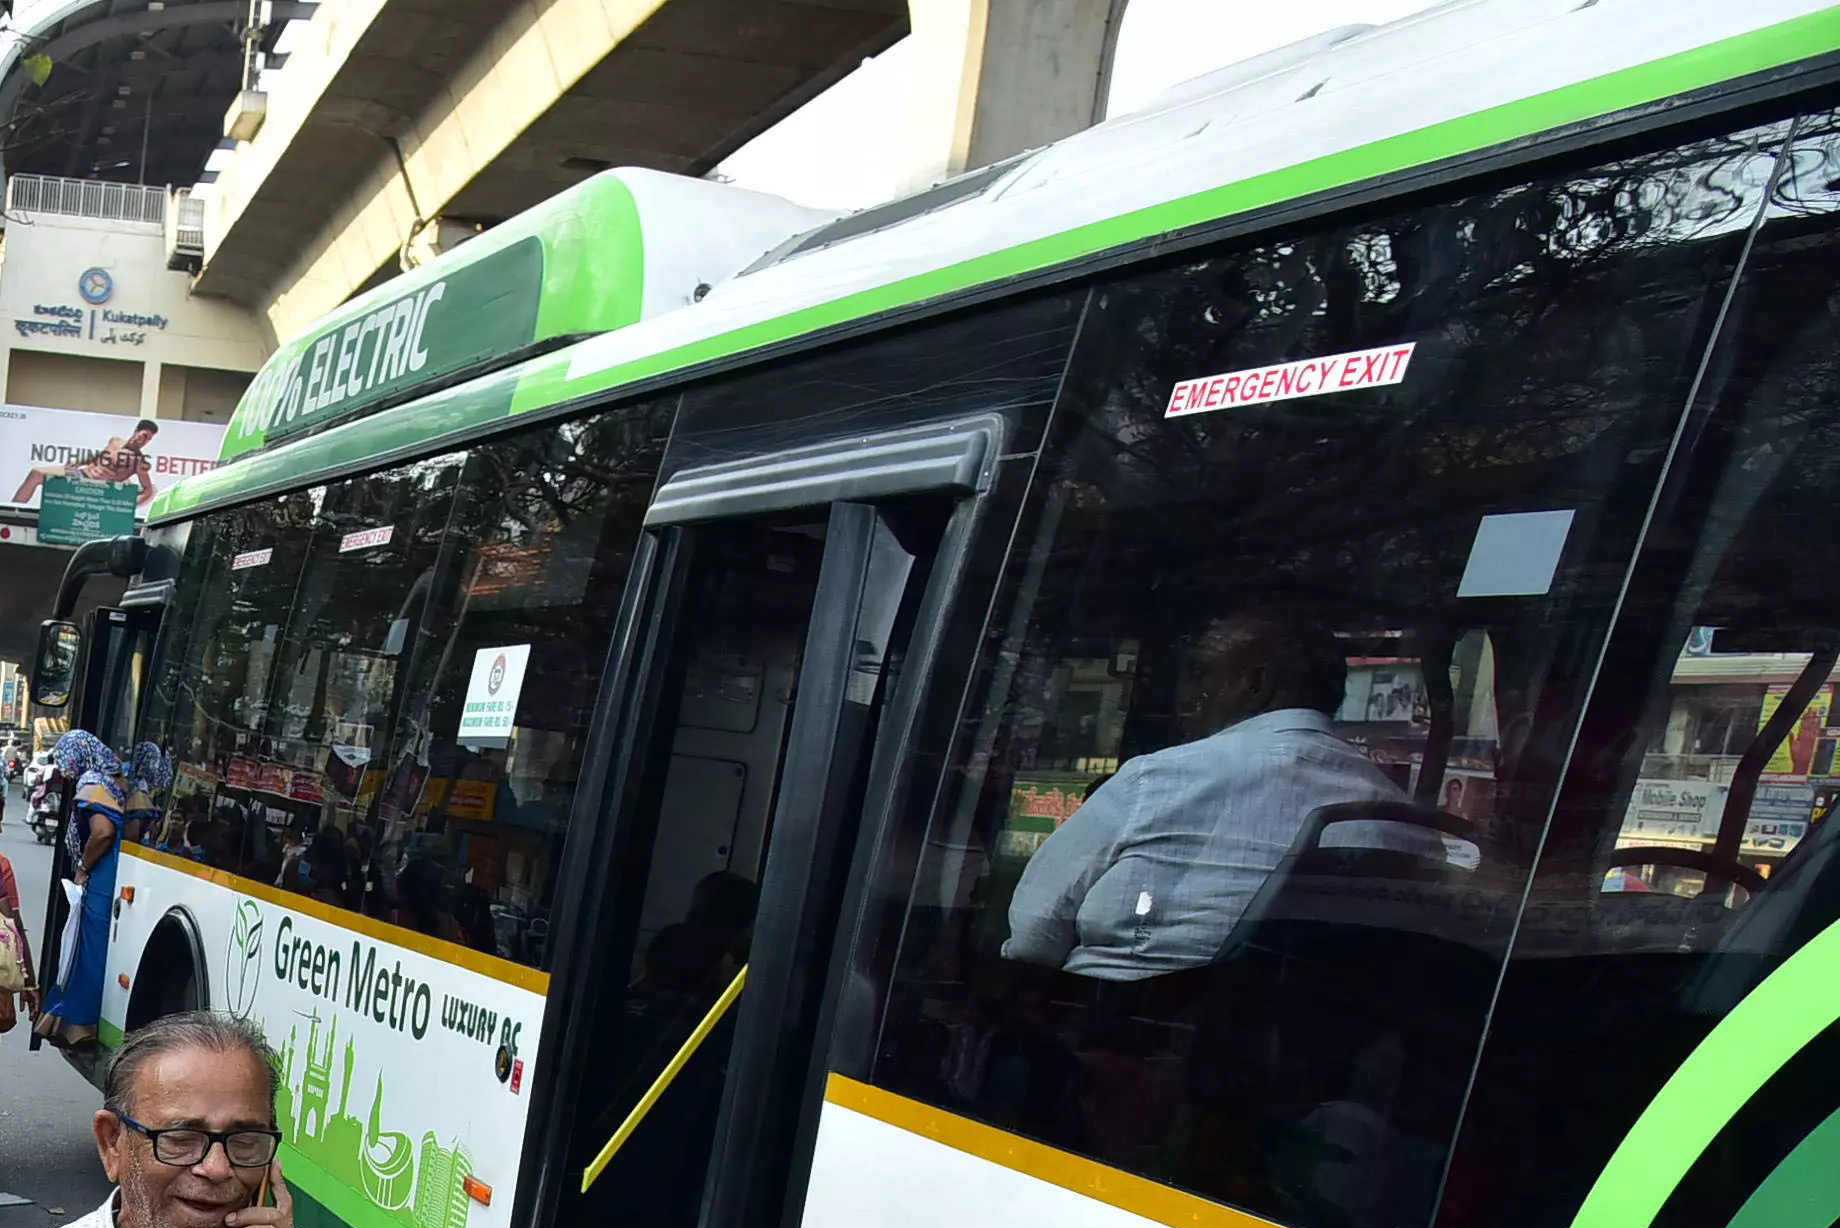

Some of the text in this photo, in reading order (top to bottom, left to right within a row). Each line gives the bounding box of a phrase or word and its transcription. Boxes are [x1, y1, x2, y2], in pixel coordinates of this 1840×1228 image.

[102, 309, 169, 330] Kukatpally
[238, 281, 447, 439] 100% ELECTRIC
[1168, 349, 1411, 413] EMERGENCY EXIT
[30, 443, 111, 468] NOTHING
[117, 451, 152, 471] FITS
[343, 528, 392, 551] EMERGENCY EXIT
[1641, 788, 1707, 812] Mobile Shop
[274, 915, 522, 1057] Green Metro LUXURY AC
